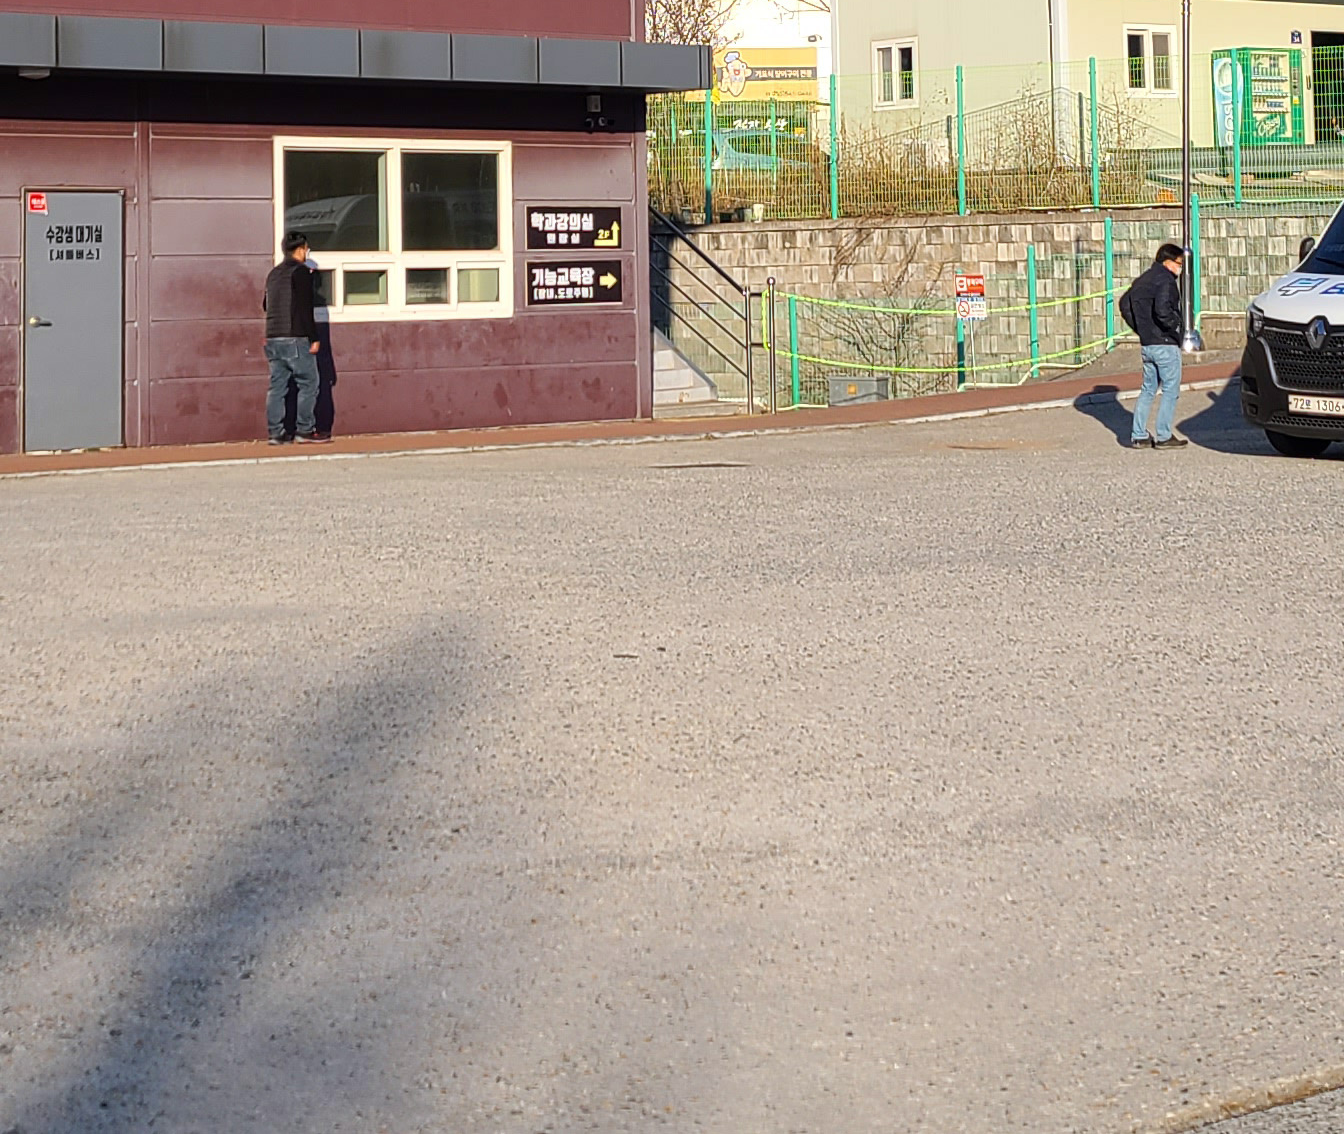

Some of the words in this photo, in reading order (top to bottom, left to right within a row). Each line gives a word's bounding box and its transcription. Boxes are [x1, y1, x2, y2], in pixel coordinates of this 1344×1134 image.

[530, 212, 594, 231] 학과강의실
[46, 225, 74, 244] 수강생
[76, 225, 103, 243] 대기실
[531, 267, 595, 286] 기능교육장
[1278, 278, 1329, 296] 부
[1317, 400, 1341, 412] 1306
